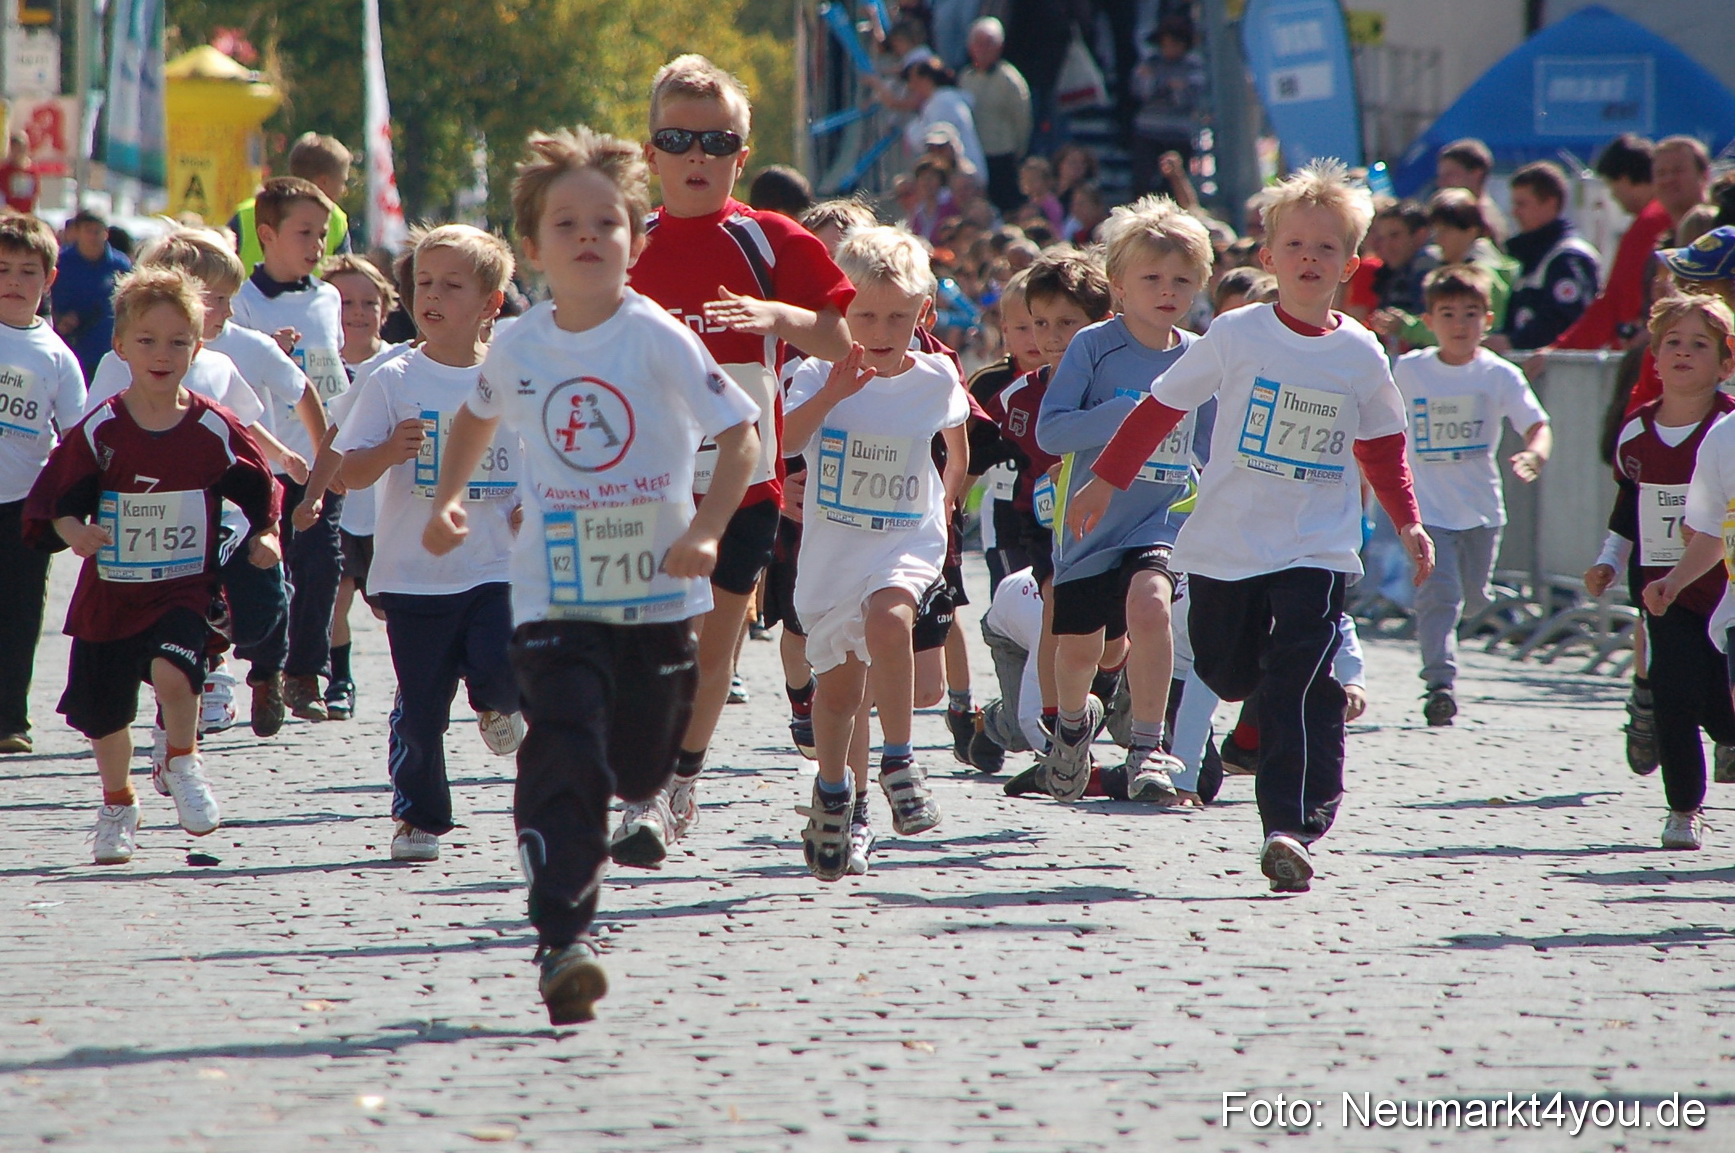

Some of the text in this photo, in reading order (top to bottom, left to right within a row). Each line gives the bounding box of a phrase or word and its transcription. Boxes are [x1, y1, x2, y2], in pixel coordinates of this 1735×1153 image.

[1284, 391, 1338, 418] Thomas
[1250, 411, 1265, 427] K2
[1433, 420, 1484, 440] 7067
[1278, 420, 1346, 455] 7128
[481, 447, 509, 472] 36
[851, 440, 898, 462] Quirin
[823, 463, 837, 478] K2
[851, 470, 920, 501] 7060
[1038, 499, 1052, 513] K2
[1658, 490, 1687, 506] Elias
[123, 500, 166, 520] Kenny
[125, 525, 196, 552] 7152
[584, 517, 644, 541] Fabian
[553, 556, 571, 572] K2
[160, 642, 197, 665] cawila
